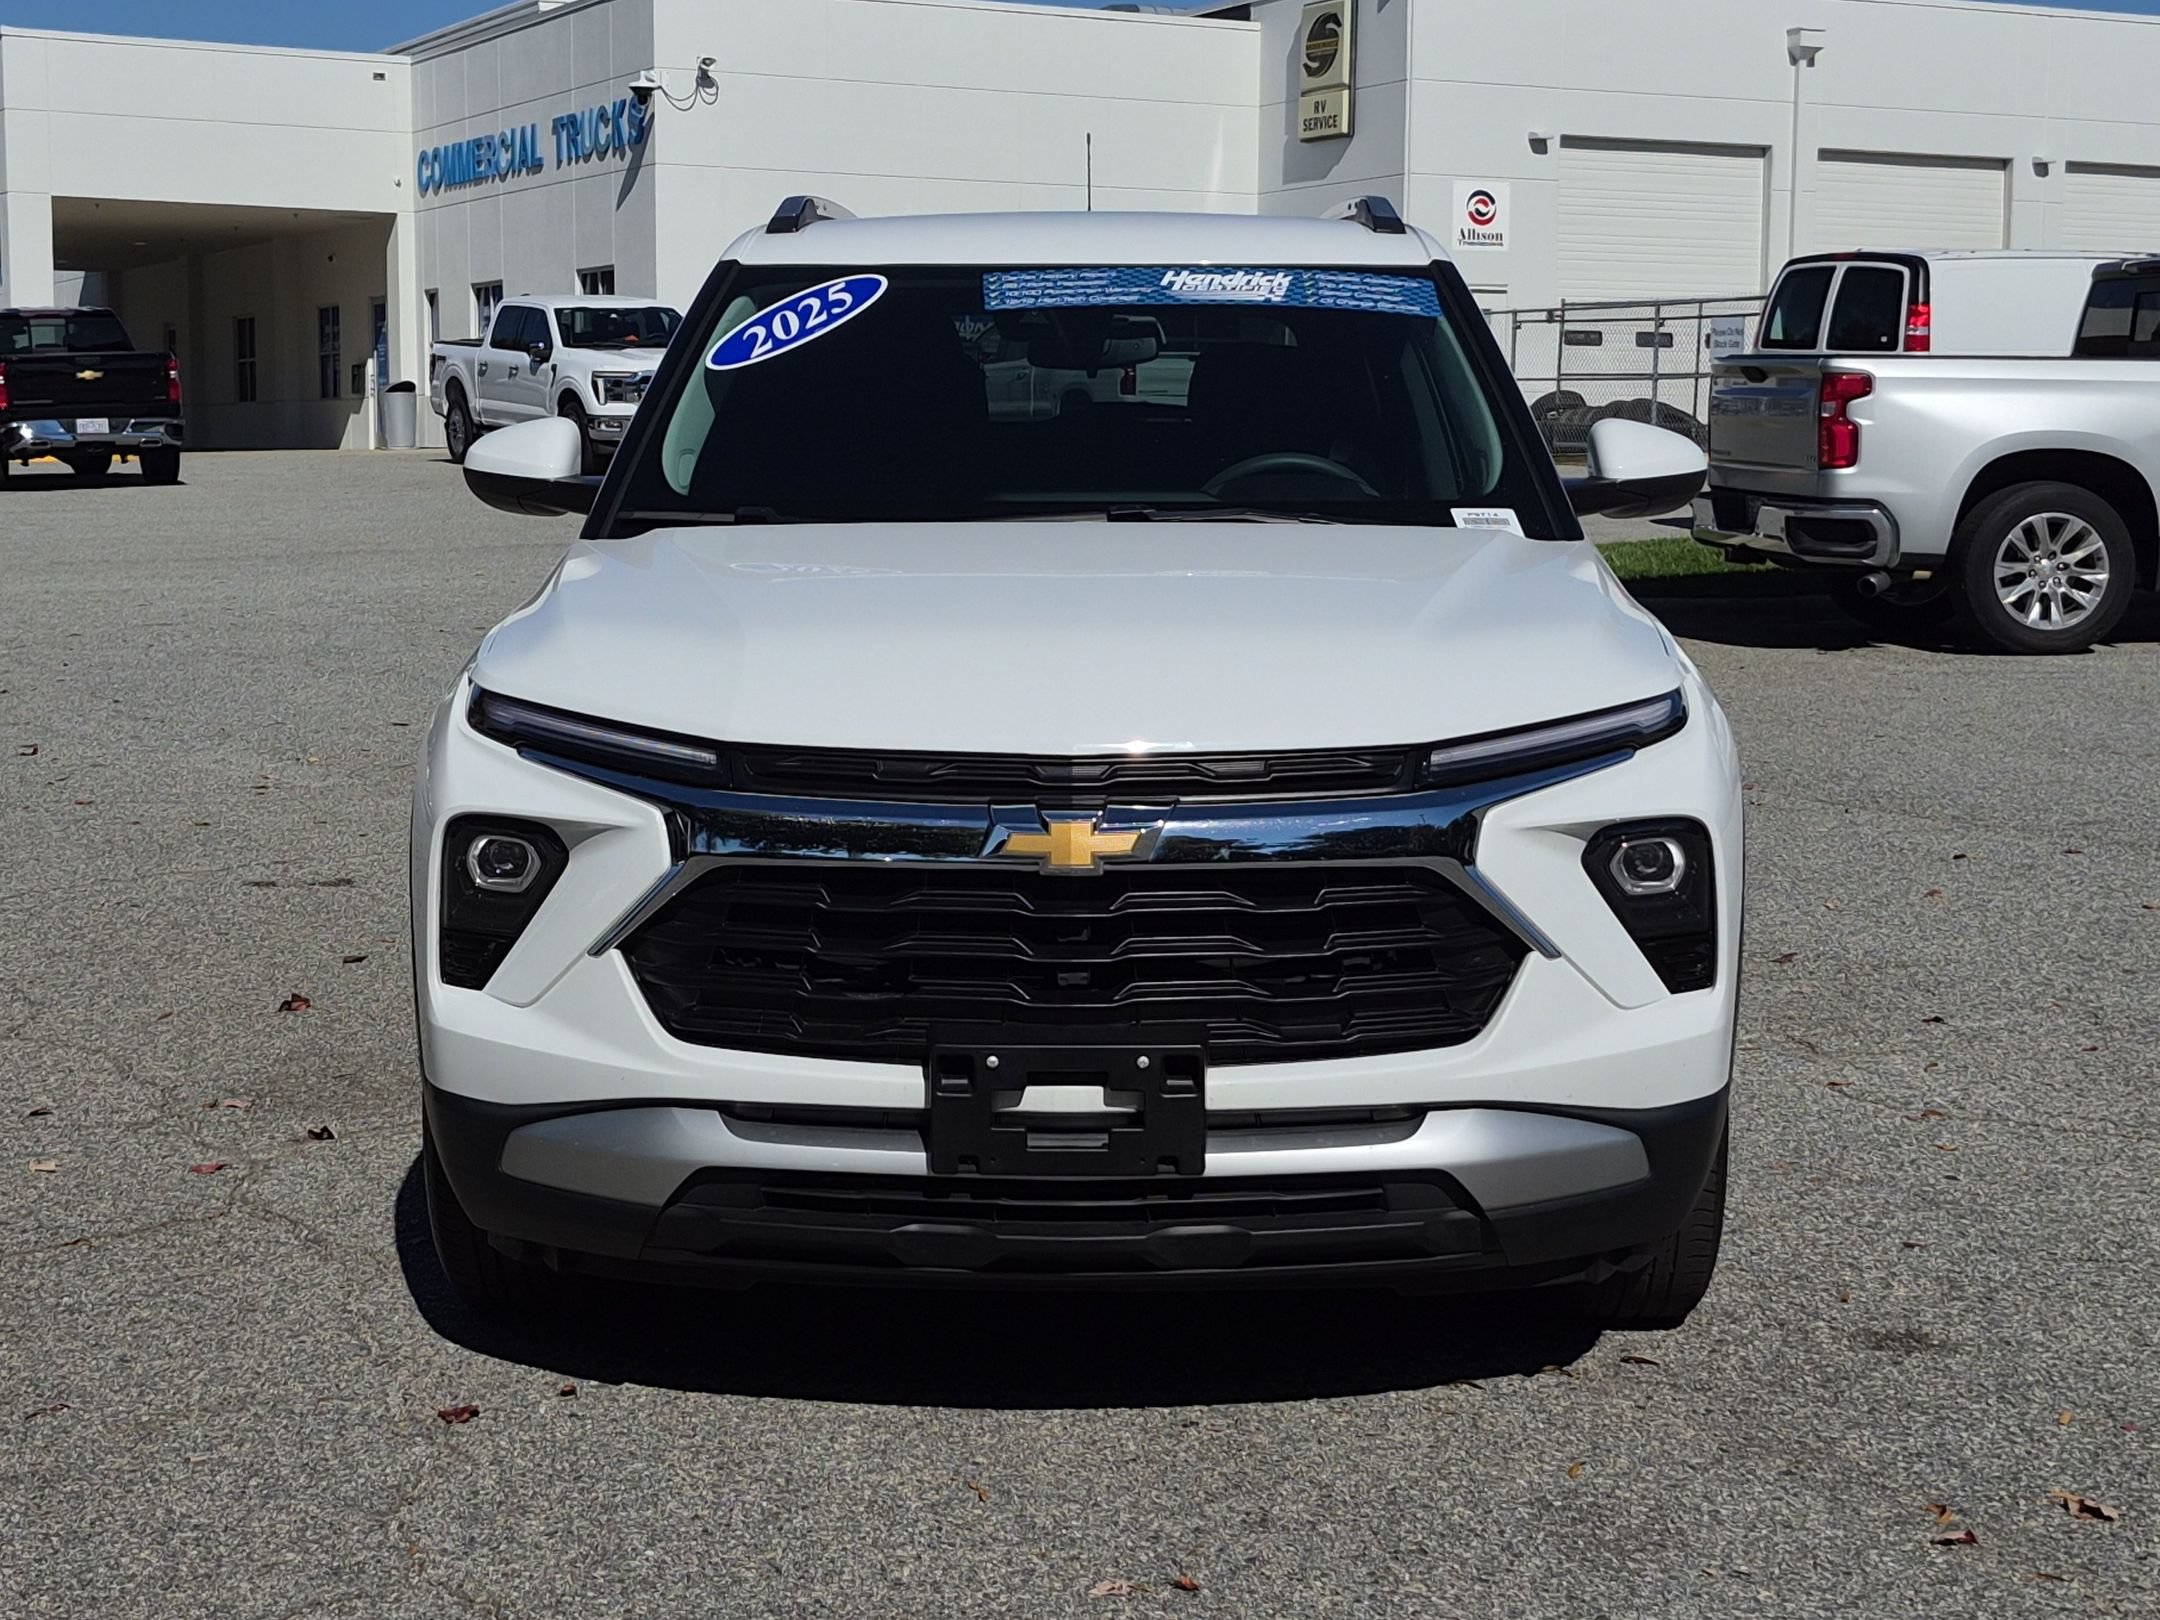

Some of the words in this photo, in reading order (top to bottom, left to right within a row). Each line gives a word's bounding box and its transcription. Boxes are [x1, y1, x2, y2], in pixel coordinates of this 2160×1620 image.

[1313, 100, 1327, 114] RV
[1302, 114, 1339, 132] SERVICE
[417, 123, 544, 193] COMMERCIAL
[552, 95, 650, 166] TRUCKS
[1458, 228, 1503, 241] Allison
[1160, 270, 1293, 291] Hendrick
[743, 281, 854, 359] 2025
